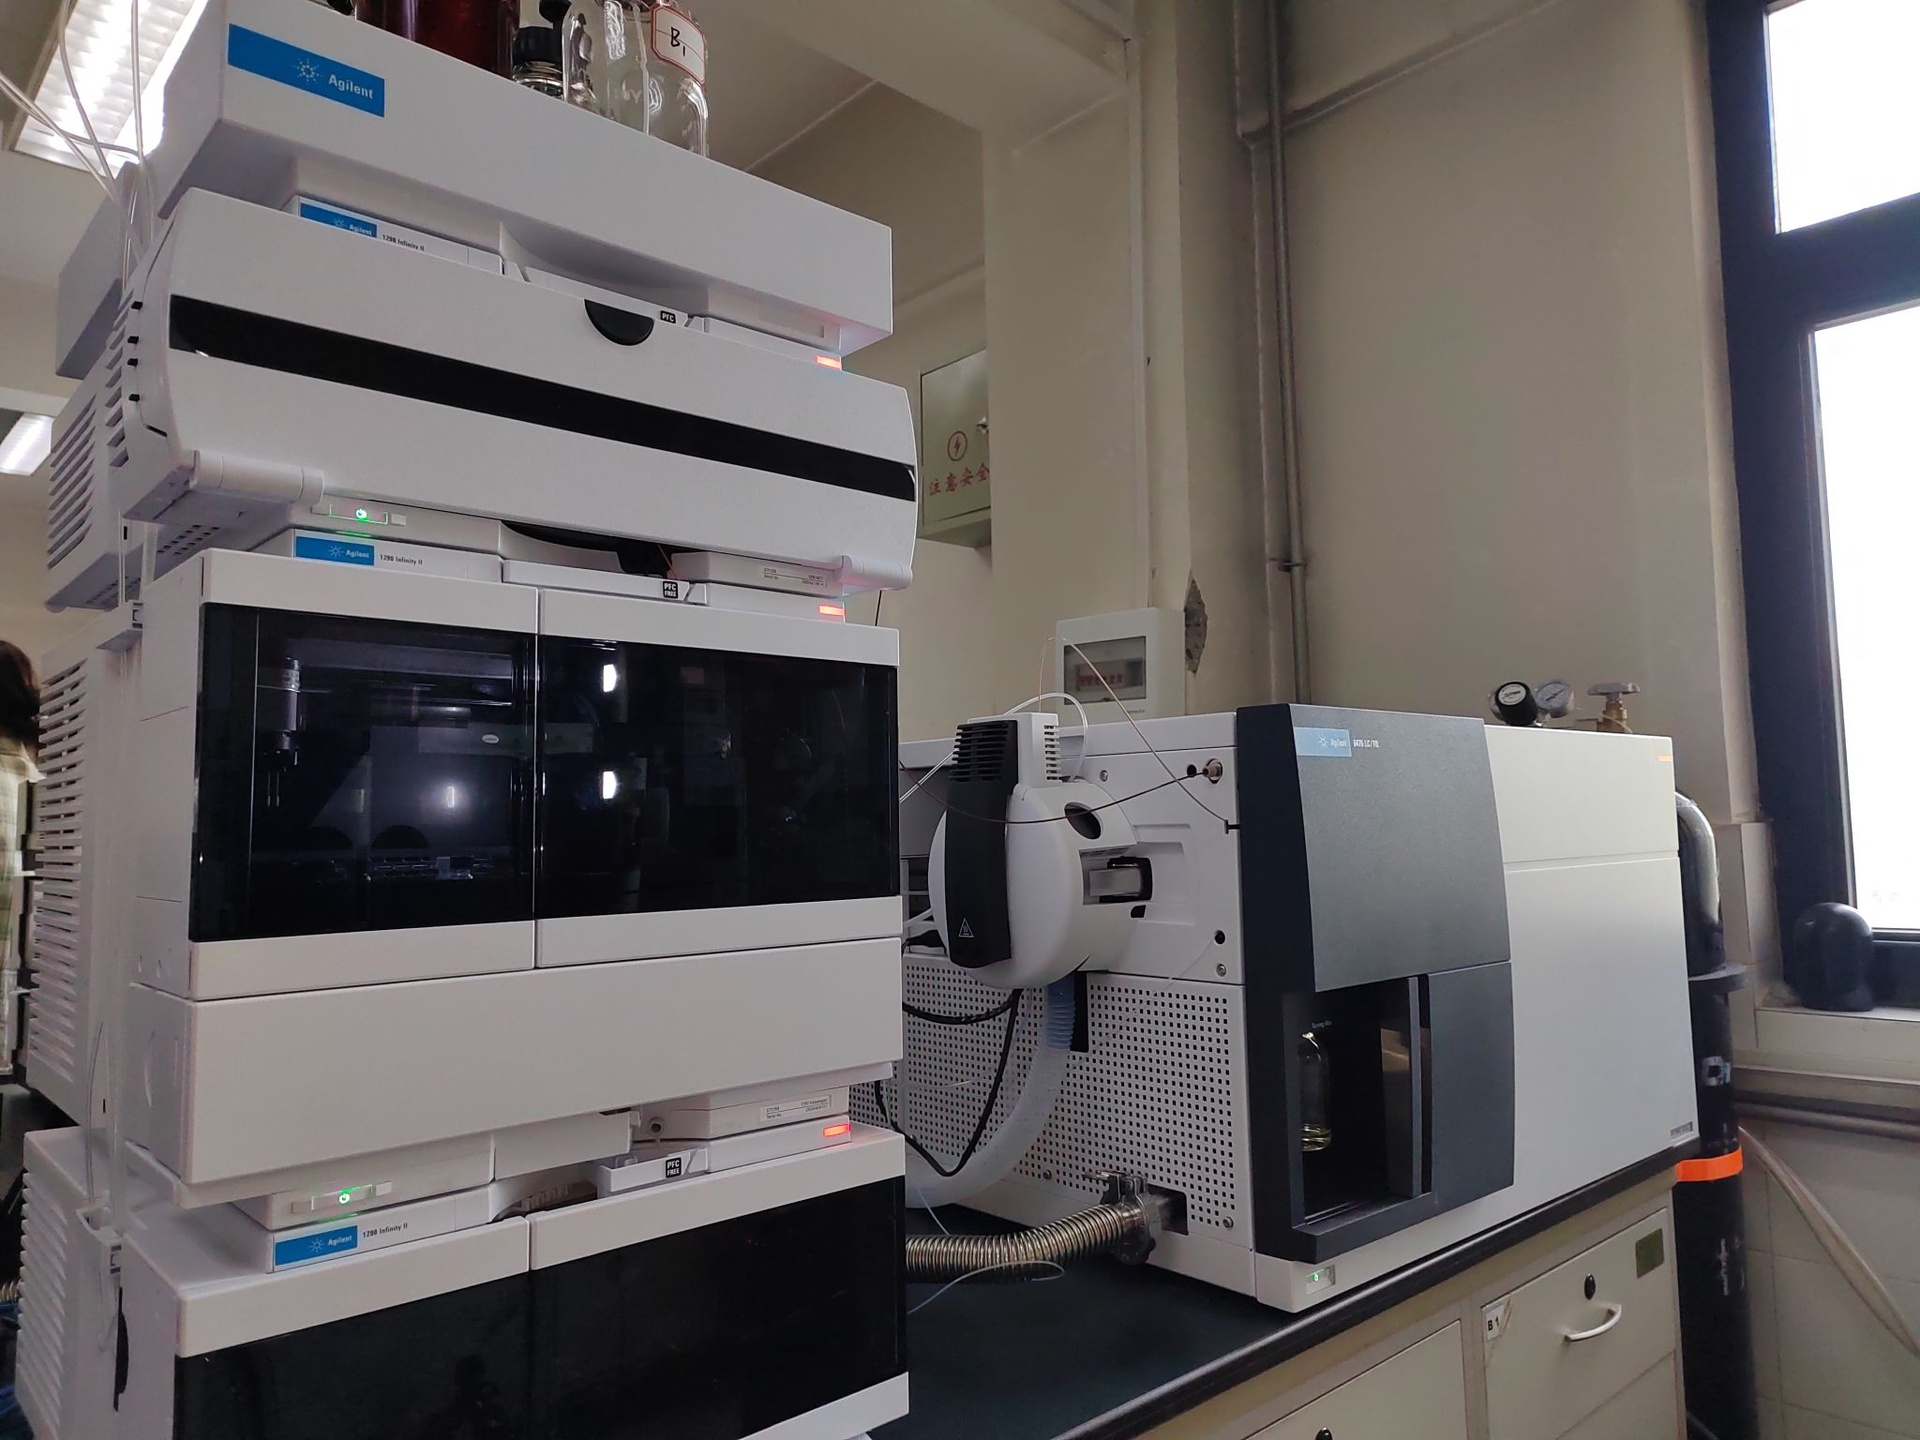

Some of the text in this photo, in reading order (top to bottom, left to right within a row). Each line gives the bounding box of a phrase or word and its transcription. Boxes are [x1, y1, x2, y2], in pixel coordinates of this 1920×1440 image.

[328, 74, 374, 99] Agilent
[349, 224, 373, 236] Agilent
[662, 312, 675, 323] PFC
[929, 462, 990, 497] 注意安全
[345, 549, 370, 559] Agilent
[395, 556, 417, 566] Infinity
[664, 582, 677, 591] PFC
[667, 1160, 680, 1170] PFC
[667, 1168, 680, 1177] FREE
[362, 1222, 409, 1239] 1290 Infinity II
[327, 1234, 353, 1247] Agilent
